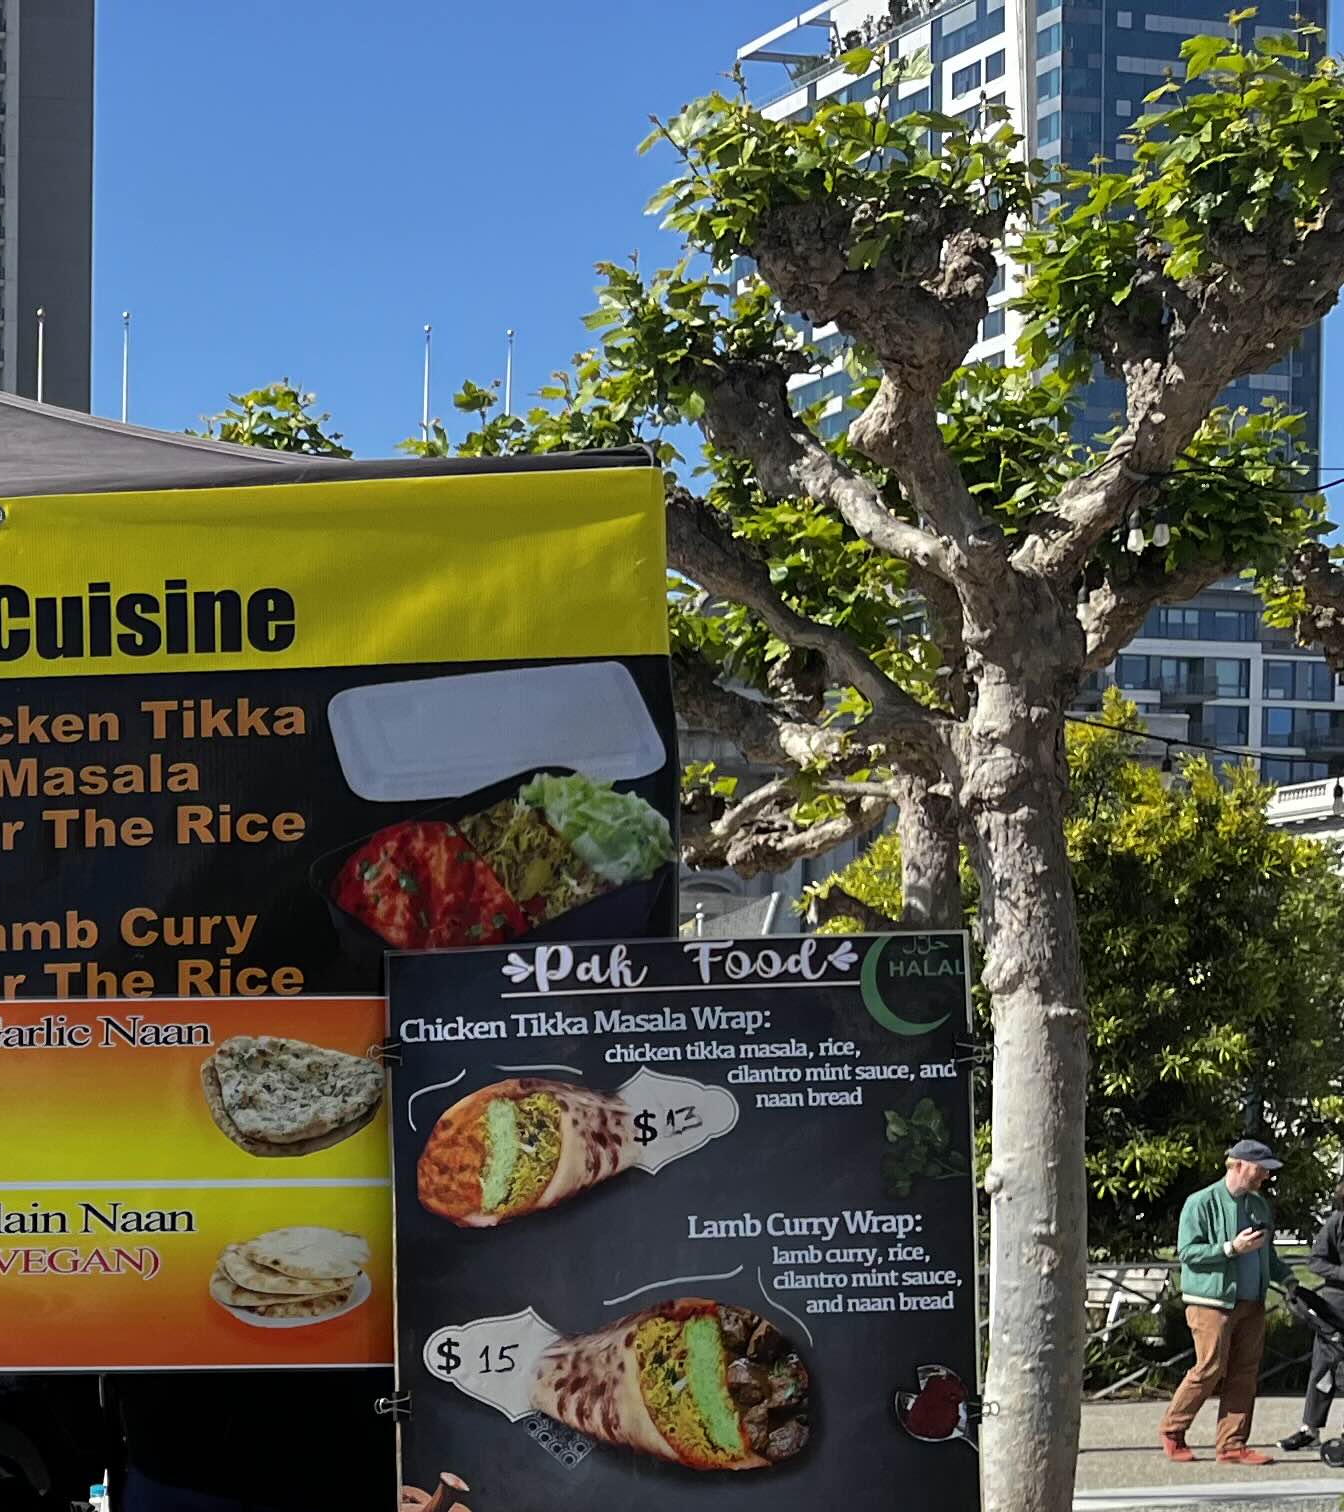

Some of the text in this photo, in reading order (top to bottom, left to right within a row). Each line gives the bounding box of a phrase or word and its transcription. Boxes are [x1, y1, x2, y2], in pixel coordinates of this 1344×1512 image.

[141, 698, 306, 740] Tikka
[42, 808, 154, 849] The
[177, 805, 306, 845] Rice
[120, 908, 258, 954] Cury
[44, 962, 155, 1000] The
[178, 959, 304, 997] Rice
[533, 939, 830, 993] Pak Food
[889, 960, 965, 977] HALAL
[97, 1016, 213, 1047] Naan
[400, 1006, 772, 1044] Chicken Tikka Masala Wrap:
[605, 1038, 861, 1063] chicken tikka masala, rice,
[727, 1059, 958, 1084] cilantro mint sauce, and
[755, 1086, 863, 1108] naan bread
[79, 1202, 198, 1234] Naan
[687, 1211, 923, 1242] Lamb Curry Wrap:
[772, 1242, 931, 1267] lamb curry, rice,
[773, 1267, 963, 1289] cilantro mint sauce,
[806, 1292, 954, 1314] and naan bread
